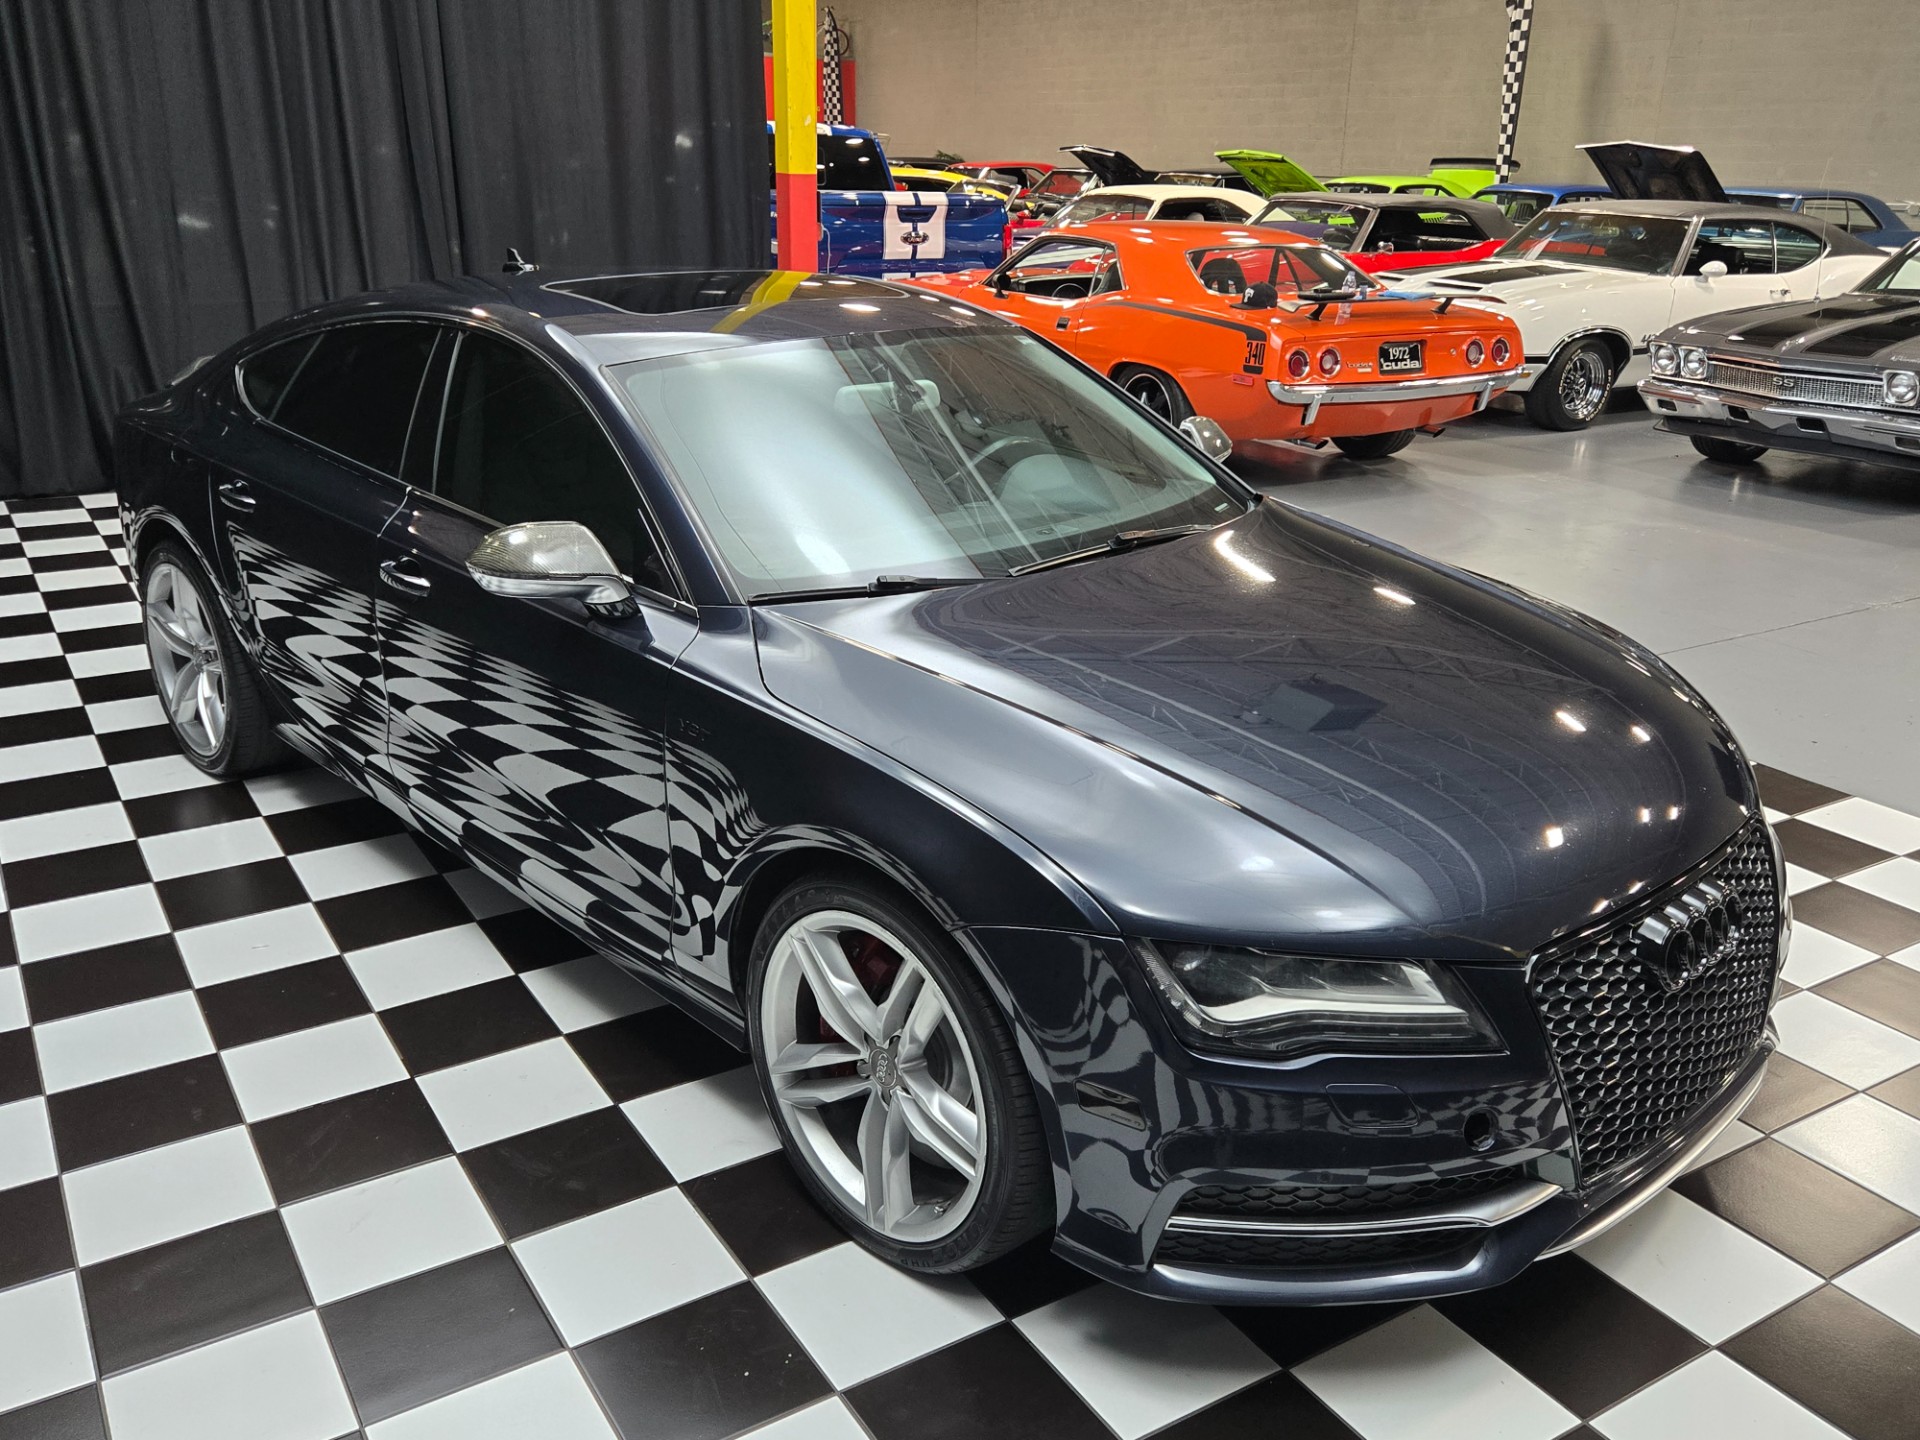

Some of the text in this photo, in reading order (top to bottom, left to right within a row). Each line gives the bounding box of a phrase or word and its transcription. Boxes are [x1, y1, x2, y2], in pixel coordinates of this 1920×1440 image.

[1244, 341, 1266, 365] 340
[1388, 346, 1411, 360] 1972
[1772, 376, 1795, 387] SS
